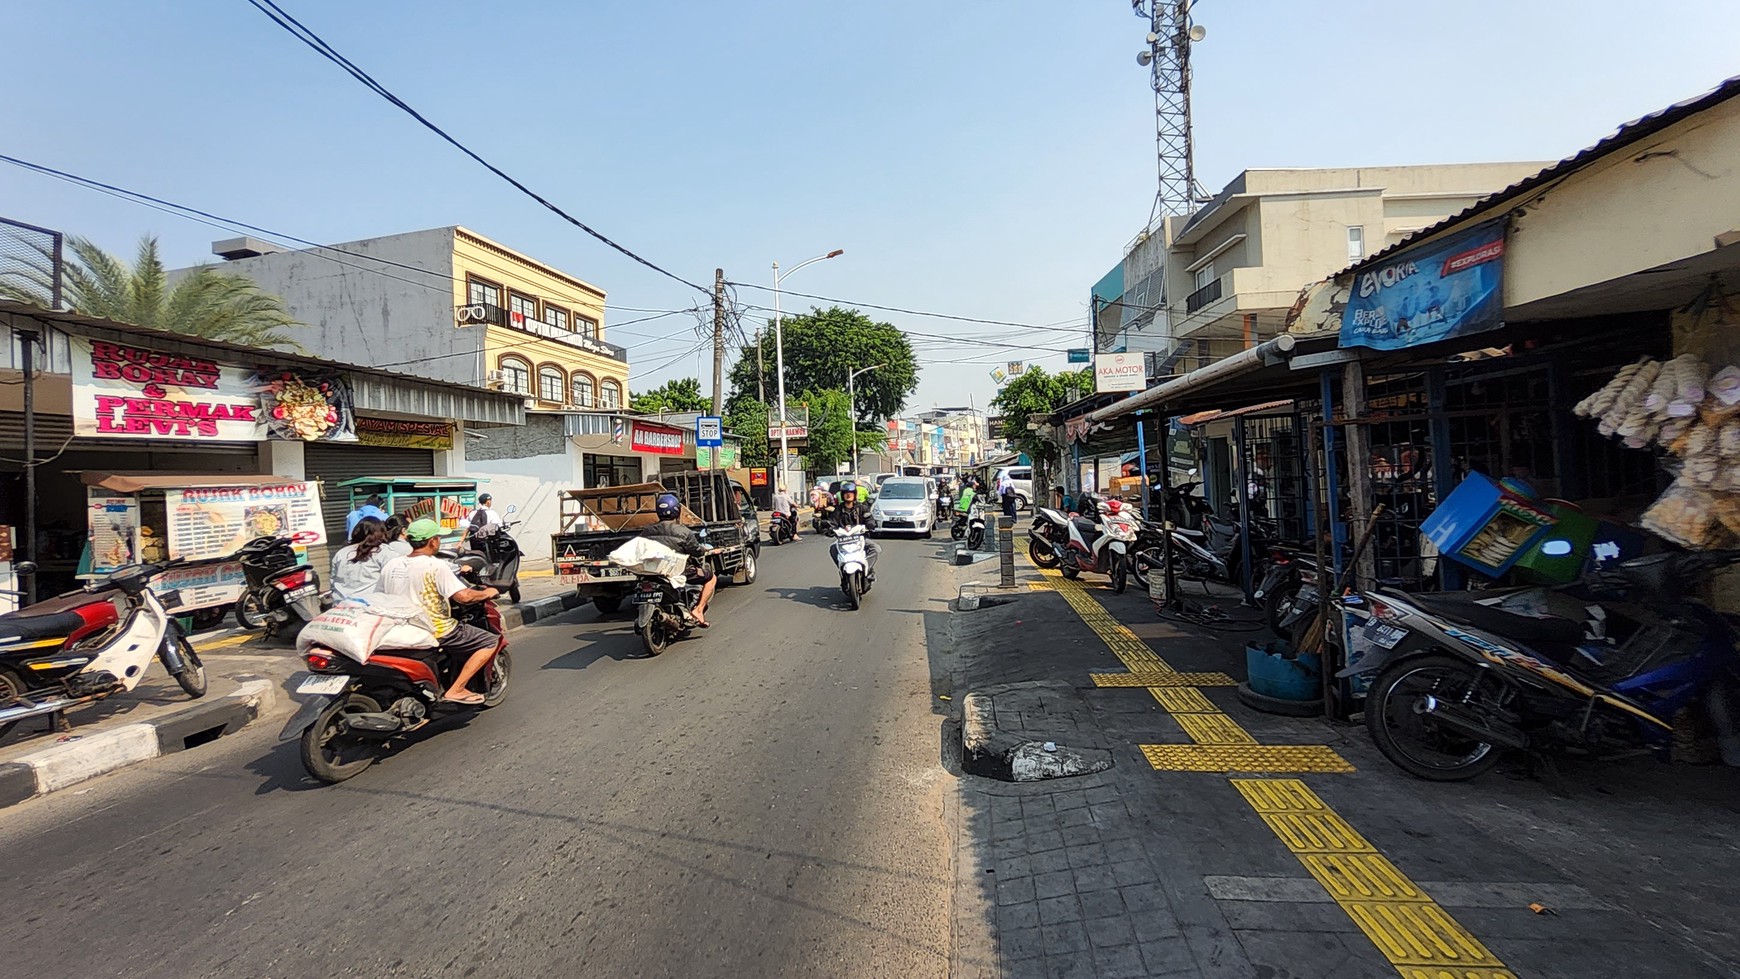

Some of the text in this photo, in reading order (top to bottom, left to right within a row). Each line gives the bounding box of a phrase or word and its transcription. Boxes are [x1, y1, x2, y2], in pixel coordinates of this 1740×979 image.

[90, 359, 221, 390] BOHAY
[1098, 365, 1144, 376] AKA MOTOR
[142, 382, 167, 399] &
[94, 394, 257, 423] PERMAK
[96, 413, 218, 438] LEVI'S
[359, 418, 397, 433] AYAM
[701, 429, 718, 437] STOP
